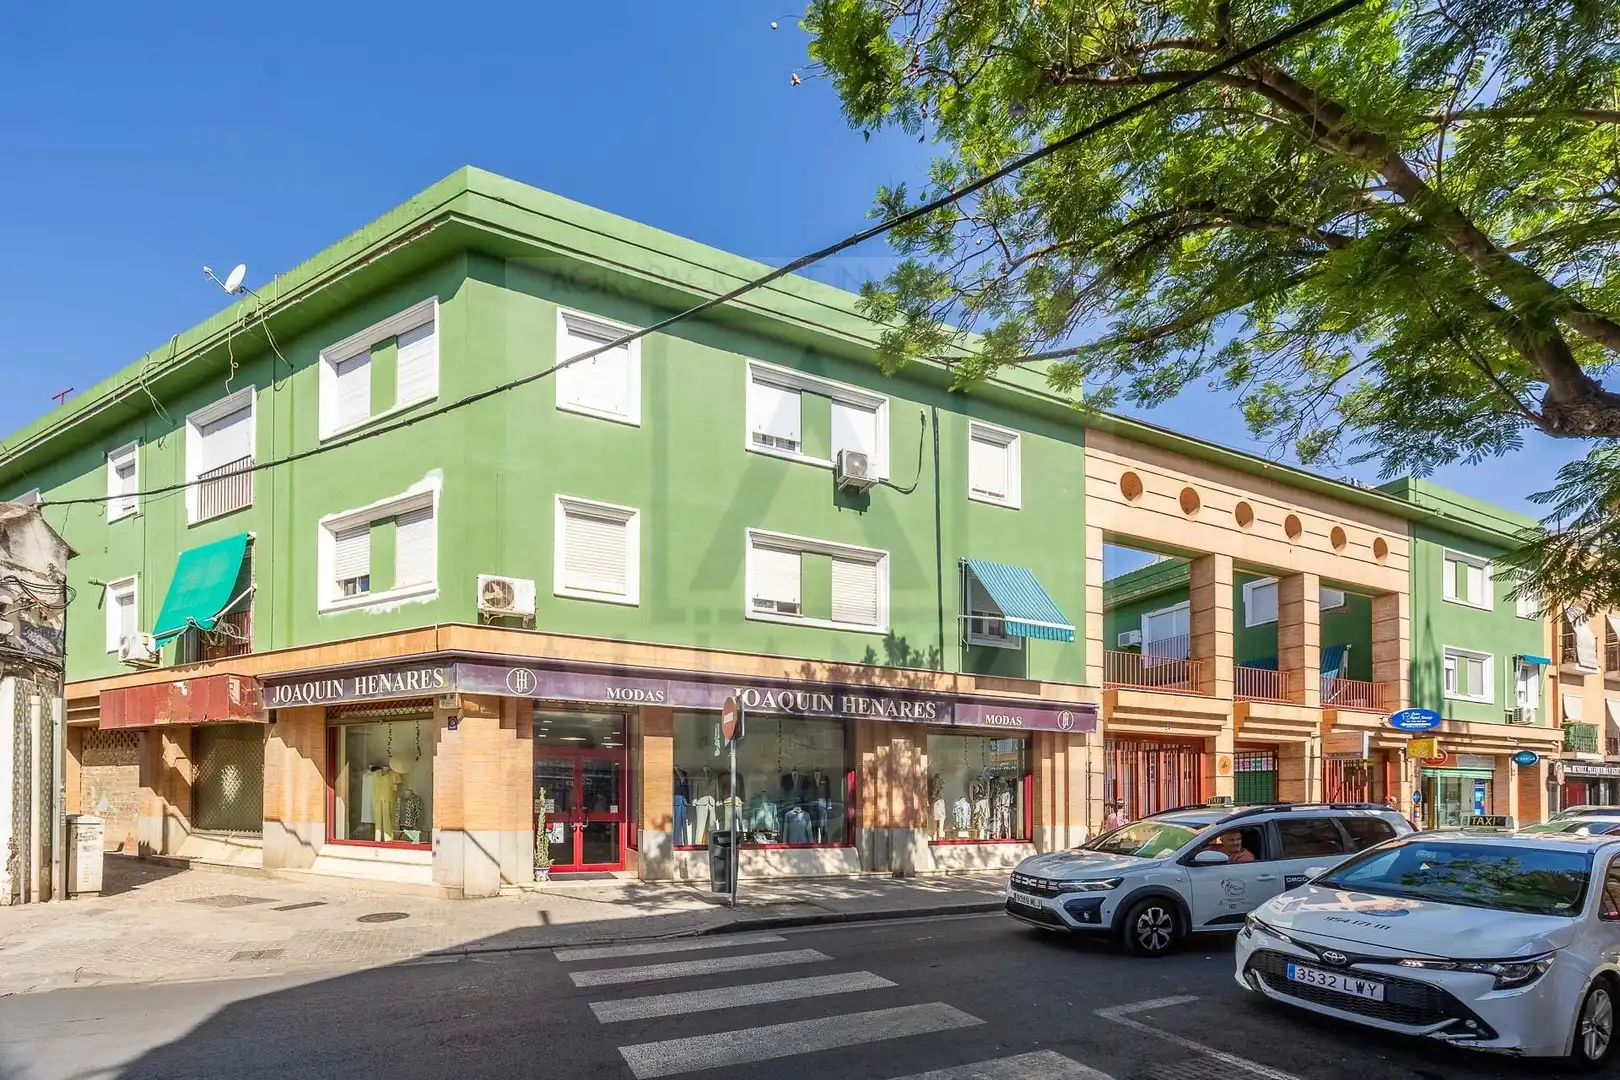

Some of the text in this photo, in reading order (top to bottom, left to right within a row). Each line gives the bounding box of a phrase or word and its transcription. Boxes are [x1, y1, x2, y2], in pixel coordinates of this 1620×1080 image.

[273, 667, 444, 704] JOAQUIN HENARES
[605, 687, 665, 703] MODAS
[733, 687, 936, 719] JOAQUIN HENARES
[985, 714, 1022, 726] MODAS
[1471, 816, 1496, 826] TAXI
[1297, 968, 1377, 997] 3532 LWY
